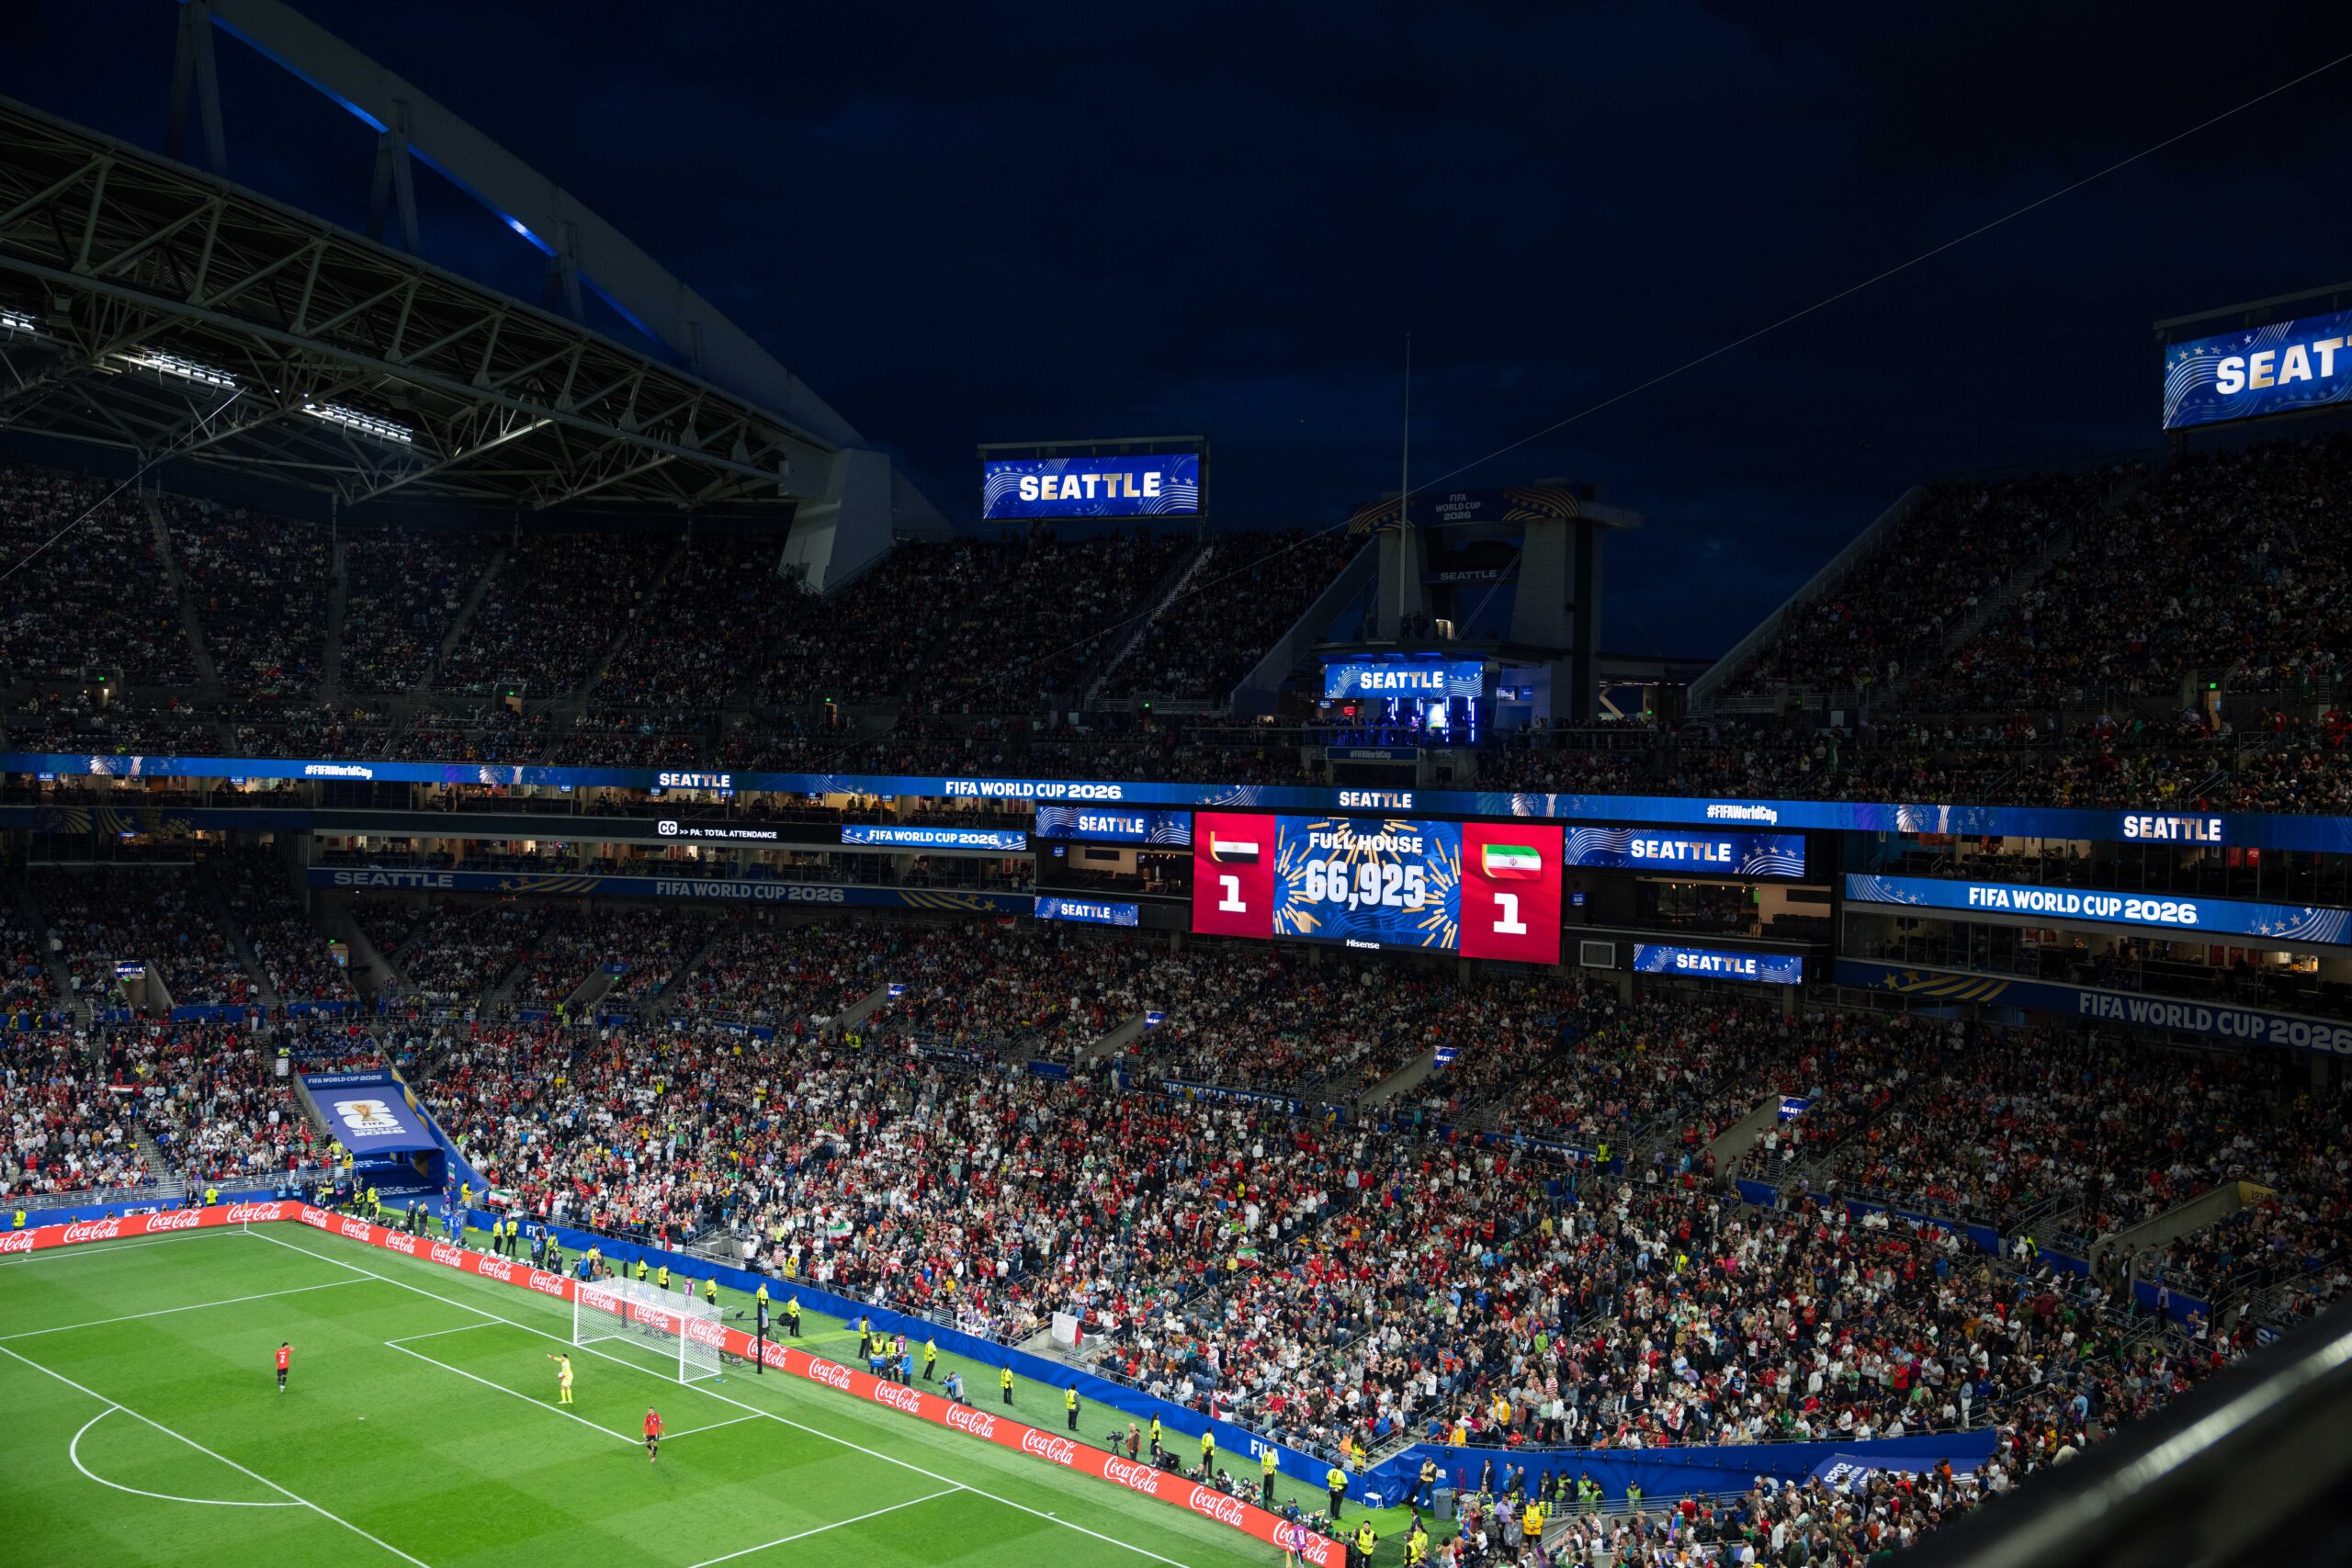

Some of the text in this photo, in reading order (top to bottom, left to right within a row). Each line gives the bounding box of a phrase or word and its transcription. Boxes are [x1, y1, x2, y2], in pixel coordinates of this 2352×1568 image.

[2215, 335, 2352, 395] SEAT
[1019, 471, 1161, 502] SEATTLE
[1449, 493, 1467, 502] FIFA
[1435, 502, 1482, 513] WORLD CUP
[1443, 511, 1472, 521] 2026
[1440, 570, 1498, 581] SEATTLE
[1361, 671, 1443, 689] SEATTLE
[1350, 750, 1392, 761] #FIFAWorldCup
[304, 765, 373, 780] #FIFAWorldCup
[659, 773, 730, 788] SEATTLE
[945, 781, 1122, 800] FIFA WORLD CUP 2026
[1339, 791, 1412, 808] SEATTLE
[1079, 816, 1144, 833] SEATTLE
[1706, 805, 1778, 826] #FIFAWorldCup
[660, 823, 676, 833] CC
[704, 829, 729, 837] TOTAL
[729, 830, 778, 840] ATTENDANCE
[869, 830, 999, 845] FIFA WORLD CUP 2026
[2123, 816, 2222, 841] SEATTLE
[1309, 832, 1423, 854] FULL HOUSE
[1631, 839, 1732, 862] SEATTLE
[334, 872, 454, 888] SEATTLE
[1306, 859, 1426, 911] 66,925
[656, 882, 845, 903] FIFA WORLD CUP 2026
[1218, 875, 1247, 912] 1
[1061, 903, 1111, 919] SEATTLE
[1493, 892, 1526, 935] 1
[1969, 887, 2198, 924] FIFA WORLD CUP 2026
[1346, 939, 1380, 950] Hisense
[1676, 953, 1756, 974] SEATTLE
[2079, 992, 2352, 1055] FIFA WORLD CUP 2026
[146, 1208, 203, 1232] Coca-Cola
[226, 1201, 285, 1223] Coca-Cola
[301, 1205, 329, 1228] Coca-Cola
[0, 1229, 38, 1252] -Cola
[63, 1218, 122, 1243] Coca-Cola
[342, 1218, 371, 1241] Coca-Cola
[386, 1230, 416, 1254] Coca-Cola
[431, 1243, 463, 1268] Coca-Cola
[479, 1256, 512, 1280] Coca-Cola
[529, 1269, 564, 1295] Coca-Cola
[689, 1317, 728, 1348] Coca-Cola
[747, 1337, 788, 1368] Coa-Cola
[809, 1358, 853, 1390] Coca-Cola
[875, 1380, 922, 1414] Coca-Cola
[946, 1403, 997, 1438] Coca-Cola
[1023, 1428, 1077, 1465] Coca-Cola
[1103, 1455, 1161, 1495] Coca-Cola
[1190, 1485, 1246, 1527] Coca-Cola
[1272, 1520, 1331, 1565] CocCola
